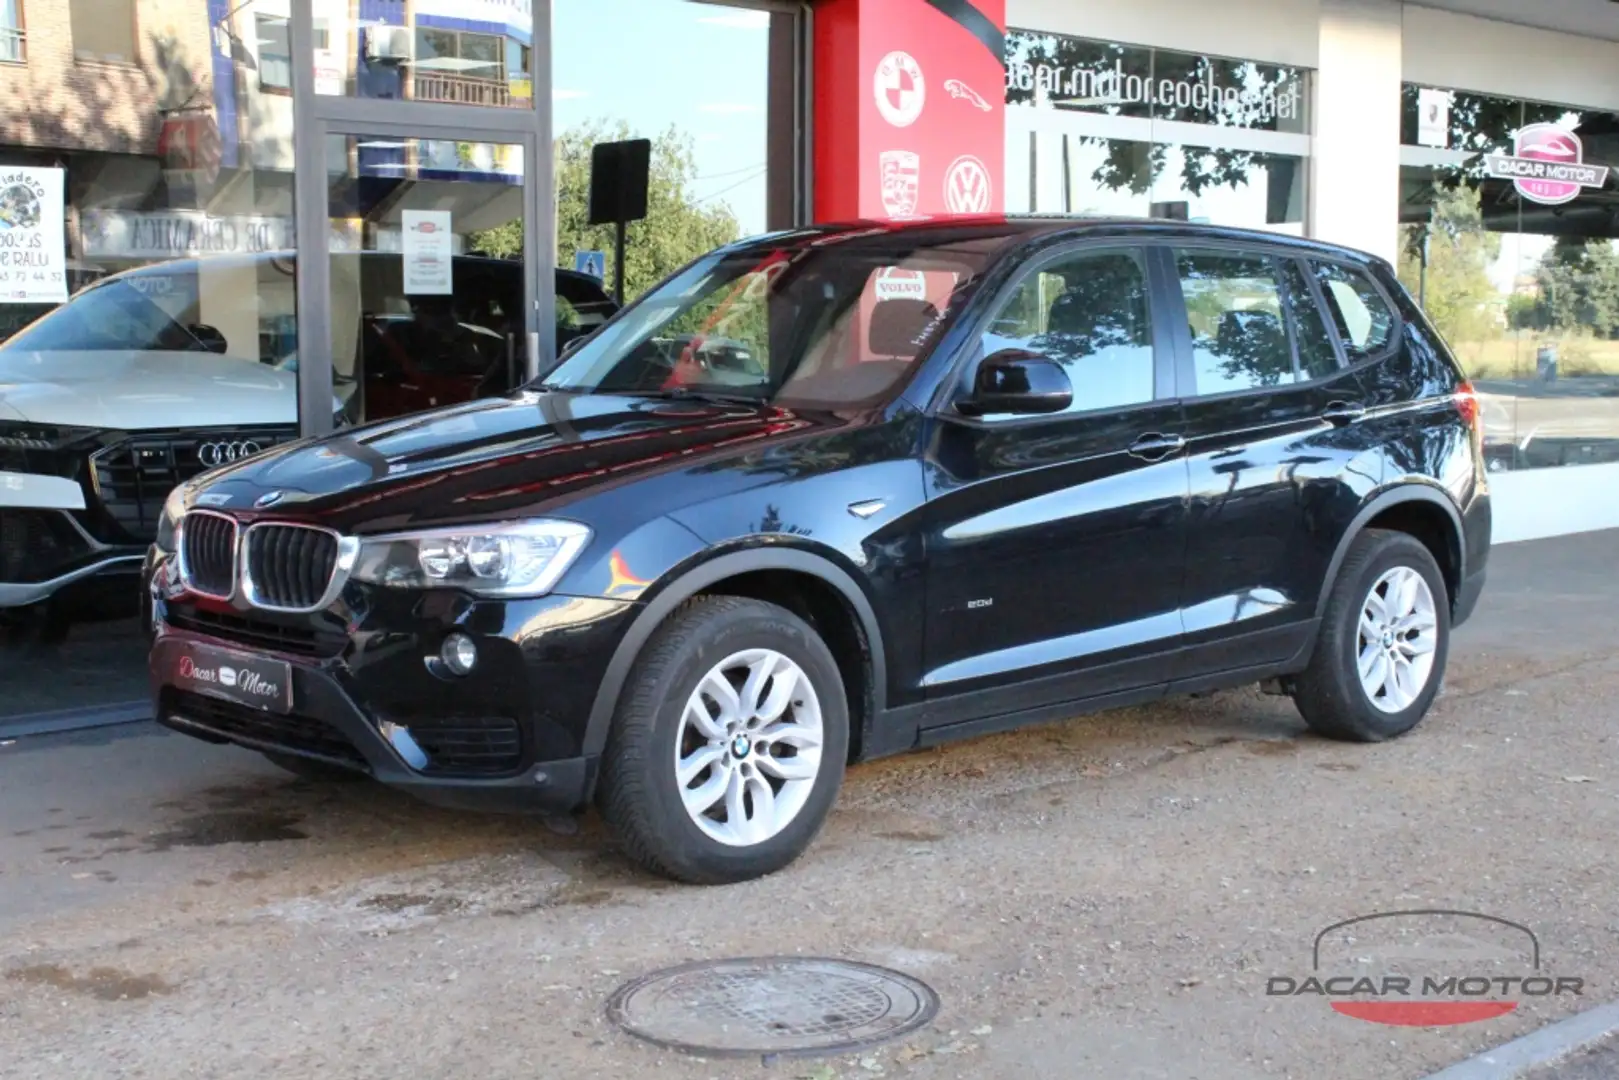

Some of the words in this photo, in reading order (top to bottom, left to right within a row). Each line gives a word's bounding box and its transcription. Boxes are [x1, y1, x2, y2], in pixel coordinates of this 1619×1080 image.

[1498, 160, 1545, 178] DACAR
[1546, 164, 1597, 182] MOTOR
[879, 283, 922, 293] VOLVO
[180, 656, 217, 683] Dacar
[238, 668, 279, 698] Motor
